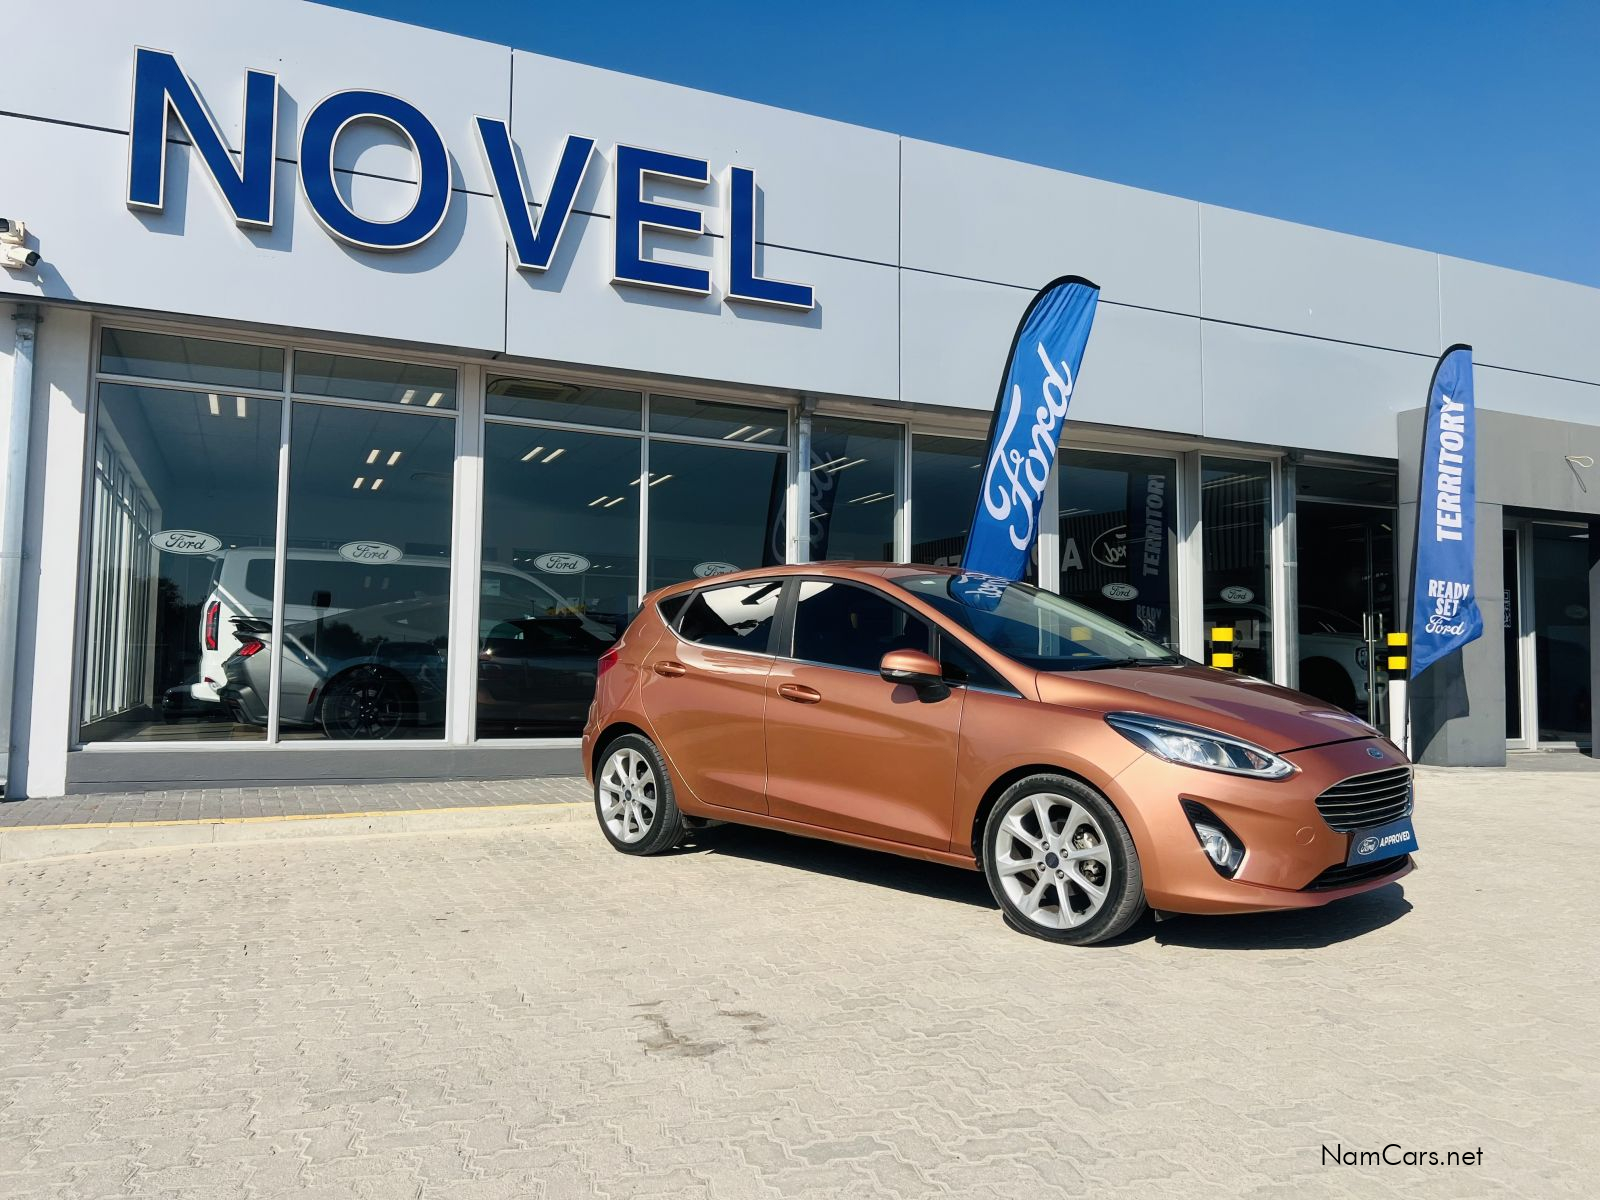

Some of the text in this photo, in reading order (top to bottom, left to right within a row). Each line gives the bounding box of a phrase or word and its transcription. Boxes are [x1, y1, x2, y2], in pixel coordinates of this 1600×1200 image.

[126, 44, 816, 312] NOVEL
[983, 342, 1073, 551] Ford
[1436, 394, 1465, 542] TERRITORY
[165, 533, 206, 550] Ford
[353, 544, 389, 560] Ford
[546, 555, 578, 570] Ford
[1428, 579, 1471, 600] READY
[1435, 597, 1460, 616] SET
[1425, 614, 1465, 635] Ford
[1379, 830, 1411, 848] APPROVED
